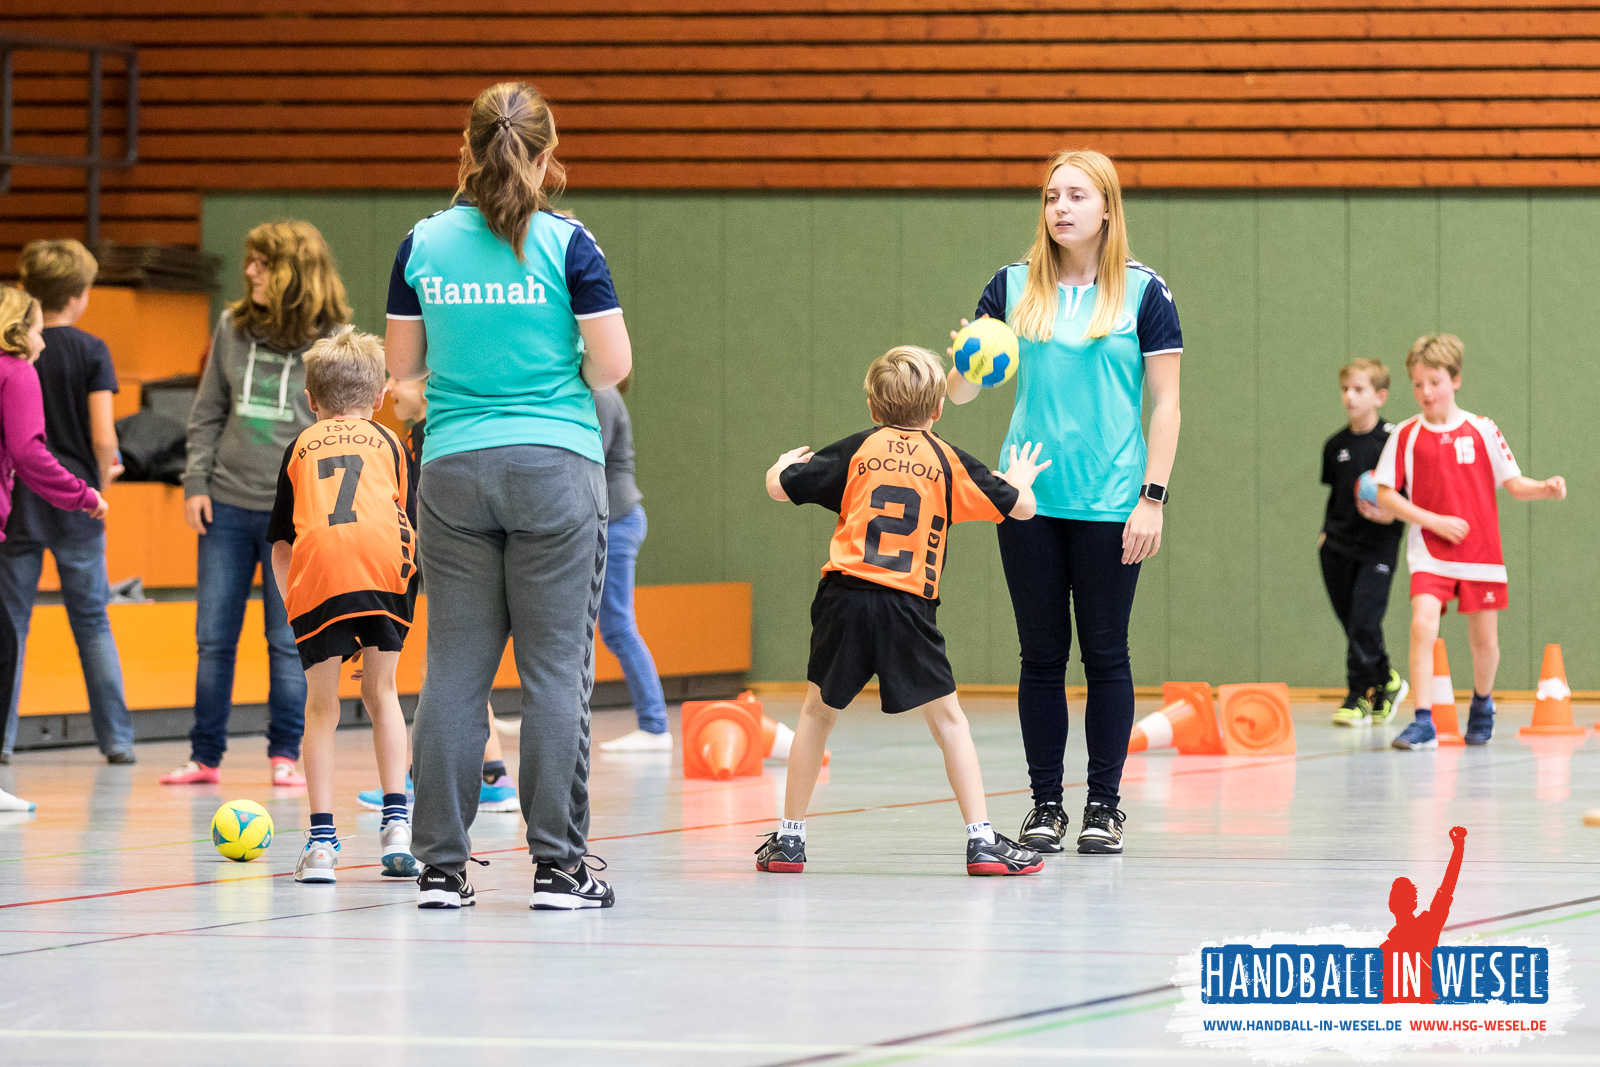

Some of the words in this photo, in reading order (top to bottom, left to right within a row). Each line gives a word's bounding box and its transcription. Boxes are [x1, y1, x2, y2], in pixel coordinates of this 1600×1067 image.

[420, 275, 547, 304] Hannah
[324, 424, 357, 432] TSV
[298, 434, 385, 459] BOCHOLT
[887, 440, 919, 456] TSV
[1453, 436, 1476, 464] 15
[858, 457, 943, 482] BOCHOLT
[317, 454, 364, 527] 7
[863, 484, 921, 573] 2
